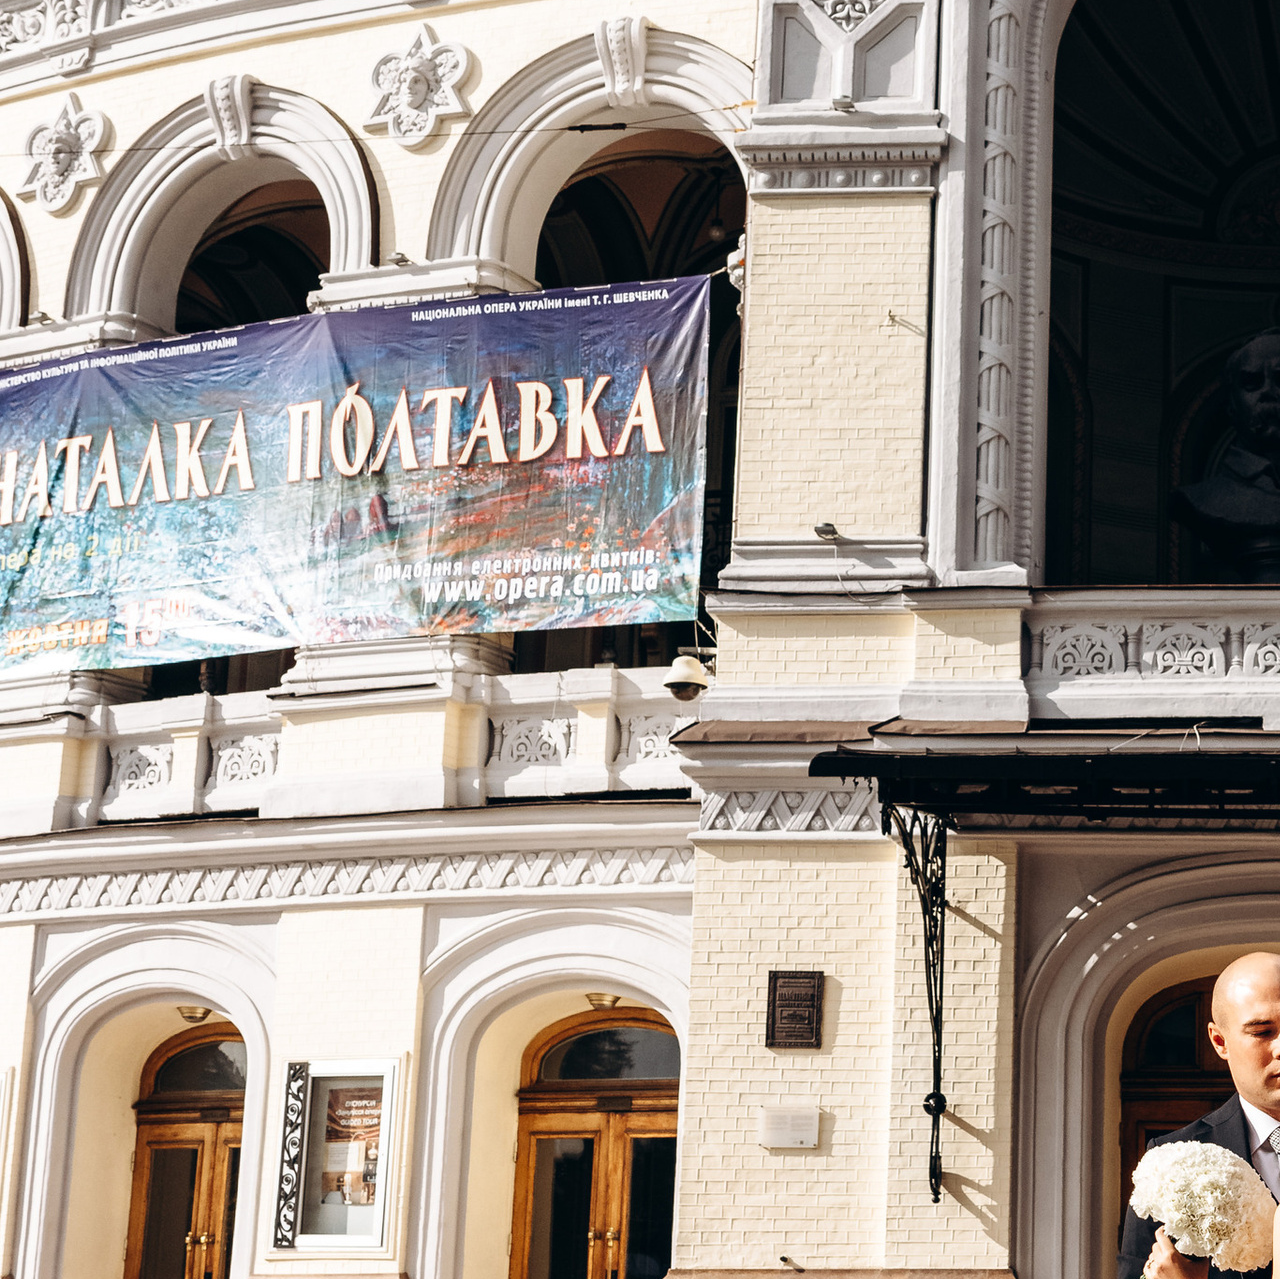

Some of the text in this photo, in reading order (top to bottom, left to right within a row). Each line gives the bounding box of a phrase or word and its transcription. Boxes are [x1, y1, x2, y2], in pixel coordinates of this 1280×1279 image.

[411, 288, 669, 322] НАЦІОНАЛЬНА ОПЕРА УКРАЇНИ імені Т. Г. ШЕВЧЕНКА
[42, 361, 79, 380] КУЛЬТУРИ
[79, 359, 89, 370] ТА
[90, 349, 158, 369] ІНФОРМАЦІЙНОЇ
[159, 342, 201, 359] ПОЛІТИКИ
[201, 336, 238, 352] УКРАЇНИ
[51, 542, 75, 562] на
[86, 535, 99, 557] 2
[373, 546, 661, 584] Придбання електронних квитків:
[423, 568, 659, 604] www.opera.com.ua
